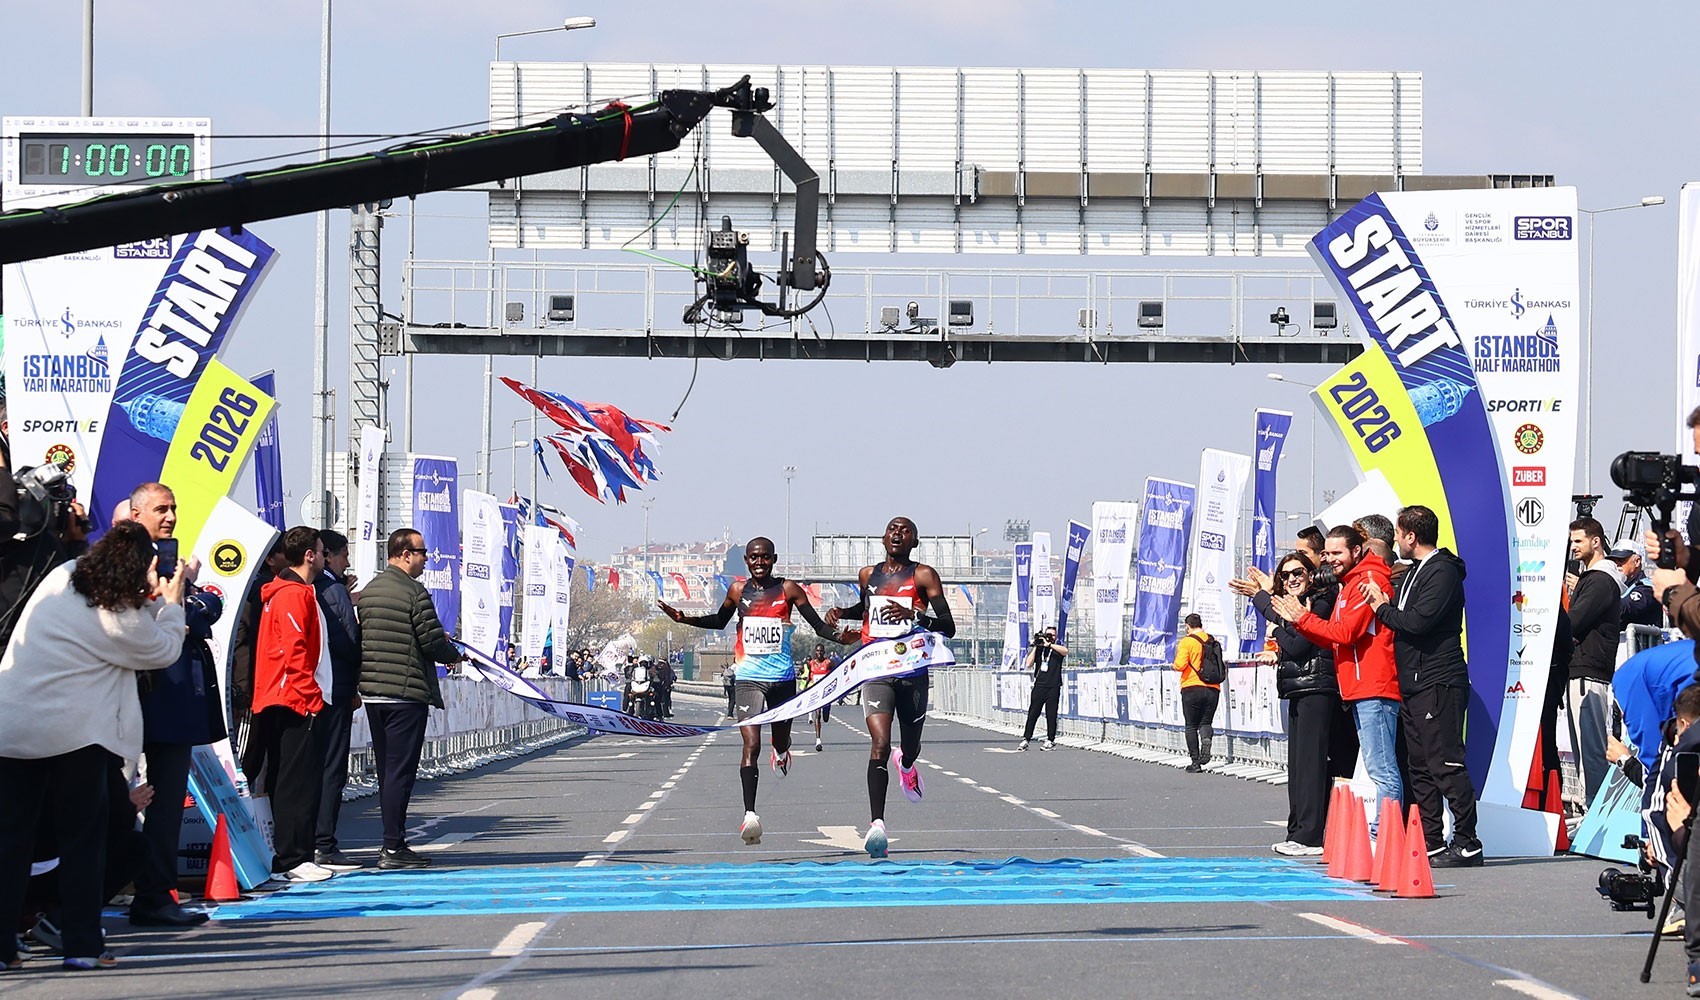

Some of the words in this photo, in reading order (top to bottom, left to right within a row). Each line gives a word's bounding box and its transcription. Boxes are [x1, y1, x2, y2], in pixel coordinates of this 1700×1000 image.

[61, 144, 191, 177] 1:00:00
[1517, 218, 1569, 231] SPOR
[1517, 230, 1569, 239] İSTANBUL
[116, 249, 170, 258] İSTANBUL
[1328, 213, 1461, 369] START
[134, 229, 258, 379] START
[1464, 299, 1508, 308] TÜRKİYE
[1526, 300, 1571, 308] BANKASI
[14, 318, 58, 328] TÜRKİYE
[77, 320, 122, 328] BANKASI
[1474, 335, 1560, 358] İSTANBUL
[23, 354, 110, 378] İSTANBUL
[1474, 358, 1500, 372] HALF
[1502, 358, 1560, 372] MARATHON
[23, 378, 47, 392] YARI
[50, 379, 111, 393] MARATONU
[1486, 396, 1562, 412] SPORTIVE
[1329, 371, 1402, 454] 2026
[23, 419, 98, 433] SPORTIVE
[190, 386, 258, 473] 2026
[1518, 499, 1542, 524] MG
[1516, 575, 1536, 583] METRO
[744, 626, 781, 643] CHARLES
[1513, 624, 1542, 634] SKG
[861, 648, 889, 661] SPORTIE
